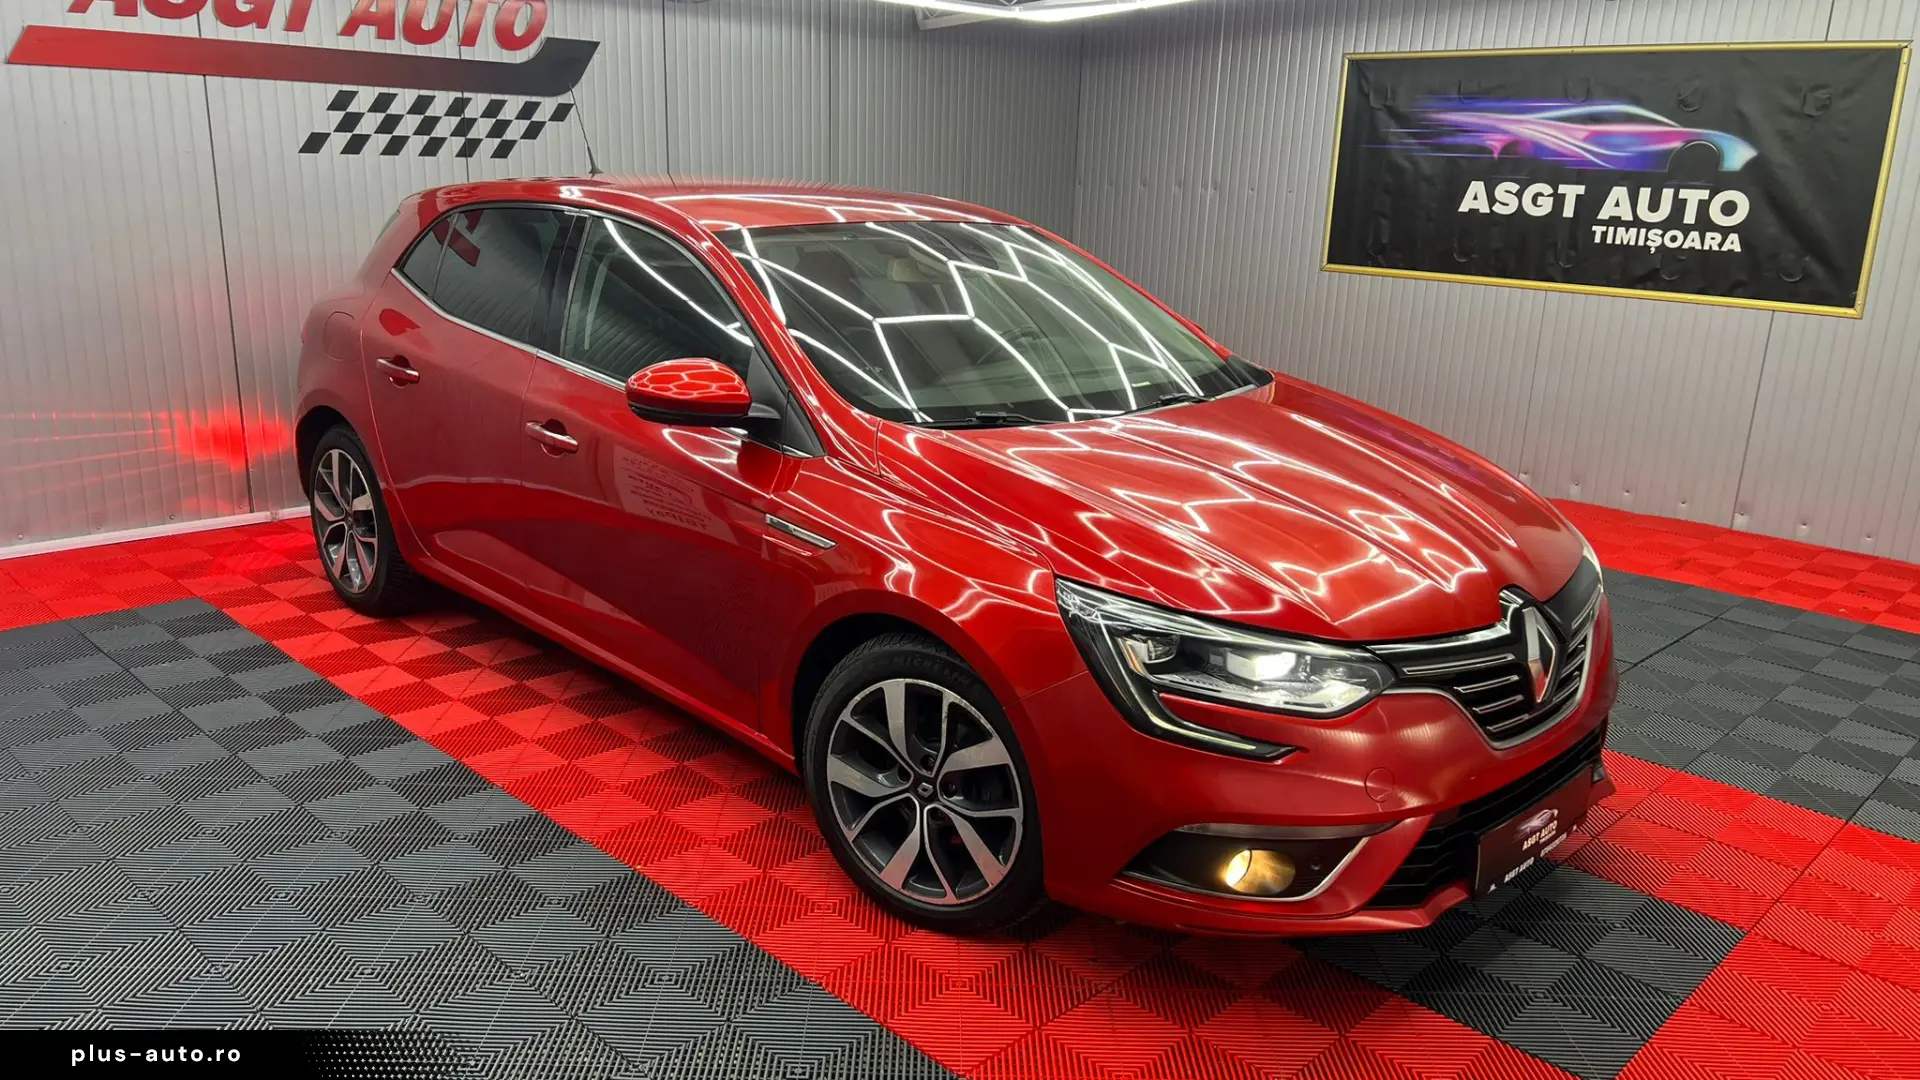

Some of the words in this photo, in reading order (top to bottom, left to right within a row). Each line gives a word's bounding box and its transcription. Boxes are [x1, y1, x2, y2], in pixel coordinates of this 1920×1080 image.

[1458, 180, 1586, 218] ASGT
[1596, 186, 1750, 227] AUTO
[1591, 225, 1742, 254] TIMIȘOARA
[1522, 832, 1540, 851] ASGT
[1540, 820, 1558, 838] AUTO
